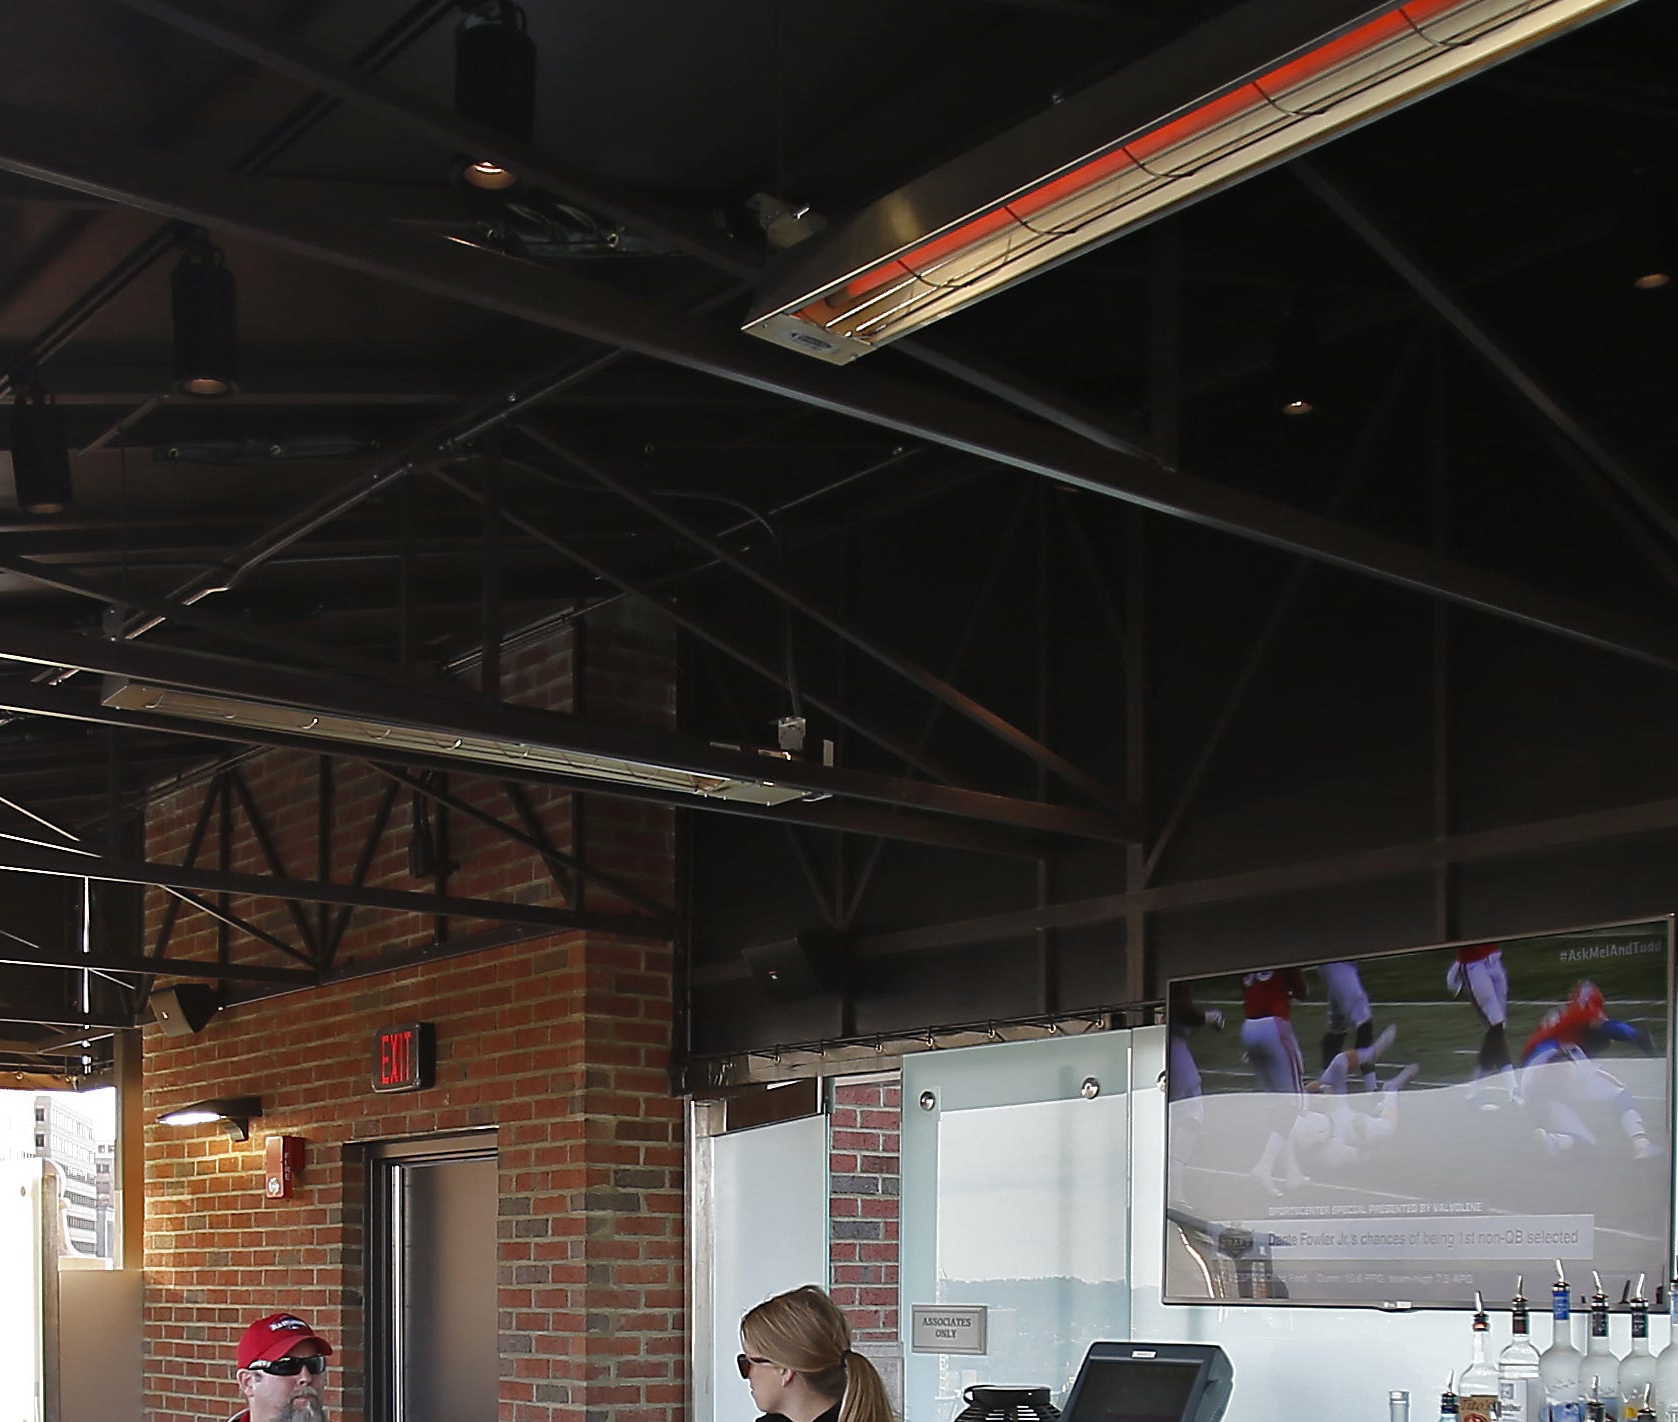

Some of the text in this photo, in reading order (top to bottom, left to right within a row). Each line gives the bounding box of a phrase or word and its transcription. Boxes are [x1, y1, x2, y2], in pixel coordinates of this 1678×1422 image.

[1559, 941, 1661, 961] #AskMelAndTodd
[381, 1031, 412, 1084] EXIT
[1331, 1204, 1367, 1215] SPECIAL
[1369, 1203, 1418, 1214] PRESENTED
[1419, 1203, 1431, 1213] BY
[1300, 1231, 1335, 1246] Fowler
[1361, 1230, 1406, 1246] chances
[1409, 1230, 1421, 1245] of
[1423, 1229, 1455, 1248] being
[1459, 1230, 1475, 1244] 1st
[1478, 1229, 1523, 1244] non-QB
[1526, 1229, 1579, 1244] selected
[923, 1317, 971, 1327] ASSOCIATES
[935, 1329, 957, 1338] ONLY
